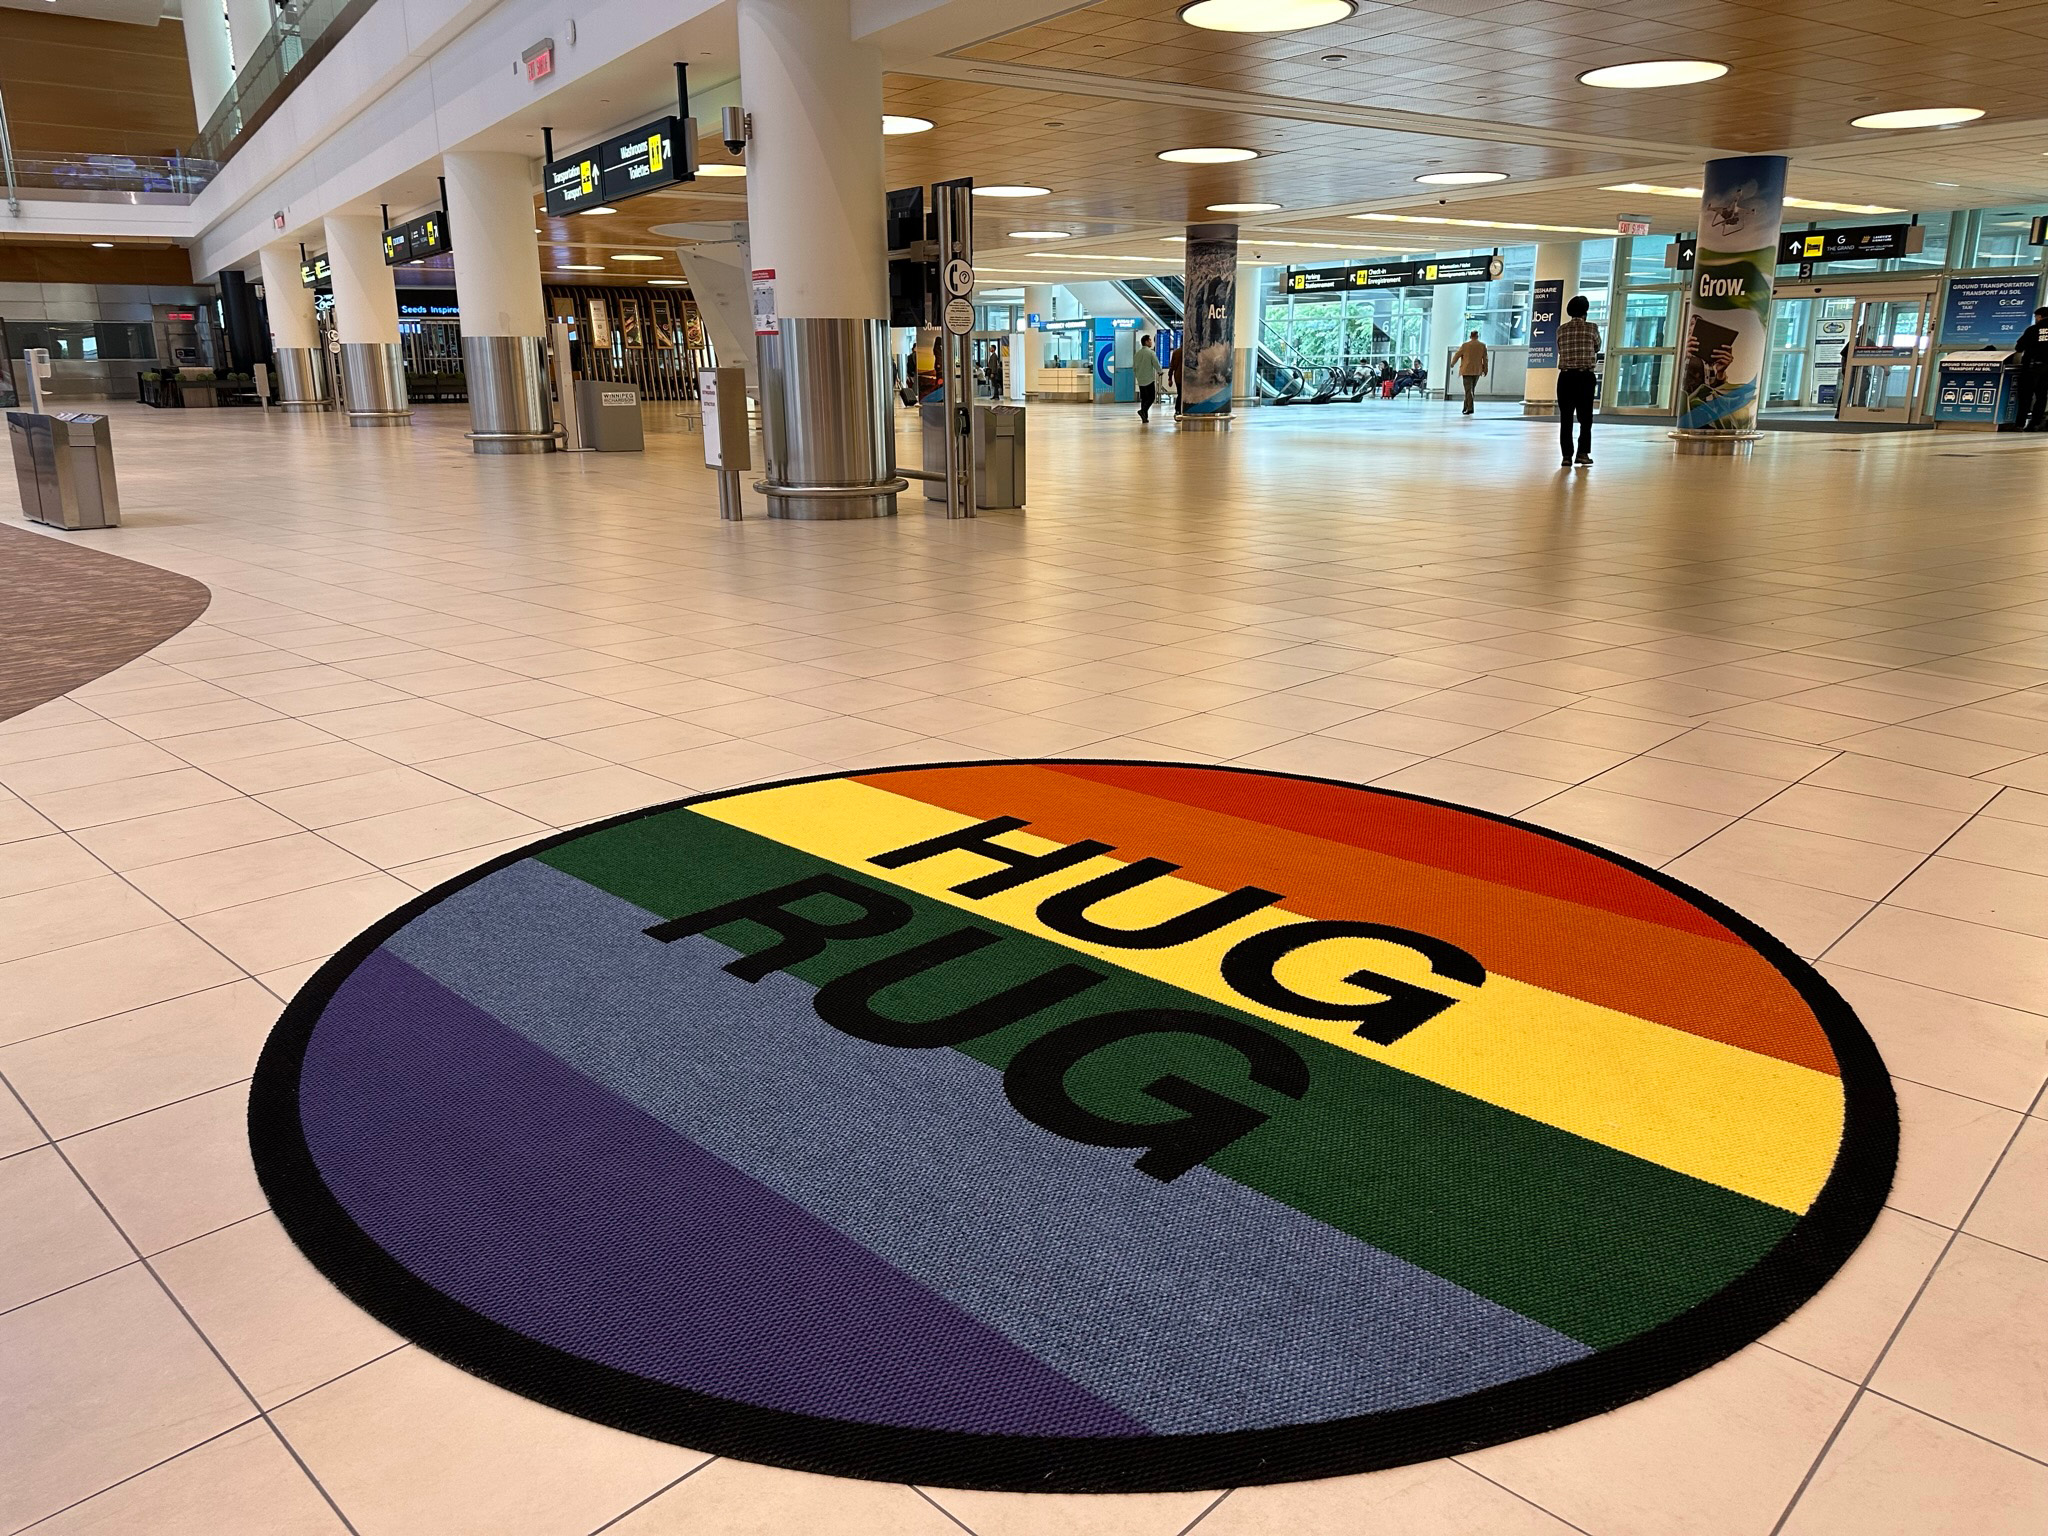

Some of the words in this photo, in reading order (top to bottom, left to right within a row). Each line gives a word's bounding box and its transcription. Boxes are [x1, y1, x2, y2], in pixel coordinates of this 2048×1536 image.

[620, 140, 649, 160] Washrooms
[553, 164, 580, 184] Transportation
[628, 161, 650, 180] Toilettes
[562, 185, 583, 201] Transport
[1305, 273, 1321, 281] Parking
[1800, 263, 1811, 278] 3
[1305, 281, 1335, 290] Stationnement
[1367, 276, 1402, 286] Enregistrement
[1699, 273, 1746, 298] Grow.
[1980, 281, 2035, 289] TRANSPORTATION
[401, 305, 427, 314] Seeds
[1999, 298, 2025, 306] GoCar
[1208, 303, 1228, 320] Act.
[1513, 315, 1523, 329] 7
[866, 815, 1487, 1047] HUG
[641, 872, 1310, 1184] RUG
